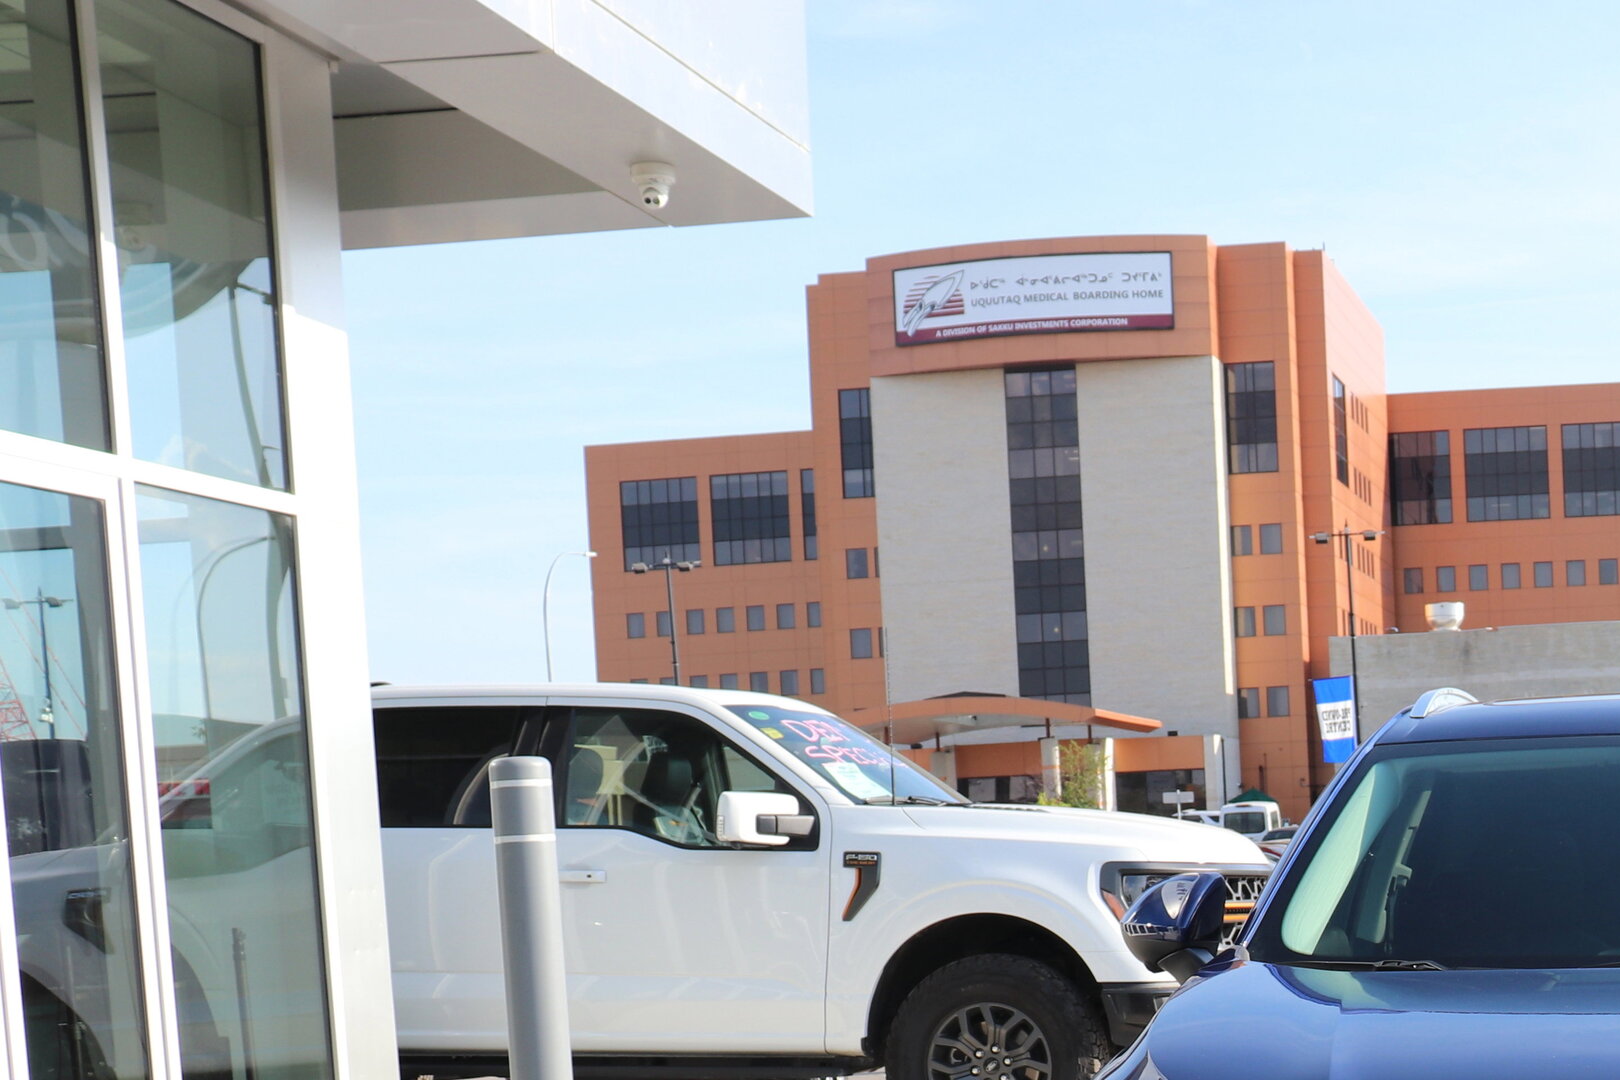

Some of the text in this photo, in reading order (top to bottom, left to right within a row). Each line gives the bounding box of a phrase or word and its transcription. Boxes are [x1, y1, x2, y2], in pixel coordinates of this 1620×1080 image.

[970, 289, 1164, 308] UQUUTAQ MEDICAL BOARDING HOME
[935, 330, 942, 338] A
[942, 326, 975, 337] DIVISION
[976, 325, 987, 334] OF
[1014, 319, 1069, 330] INVESTMENTS
[1069, 317, 1128, 327] CORPORATION
